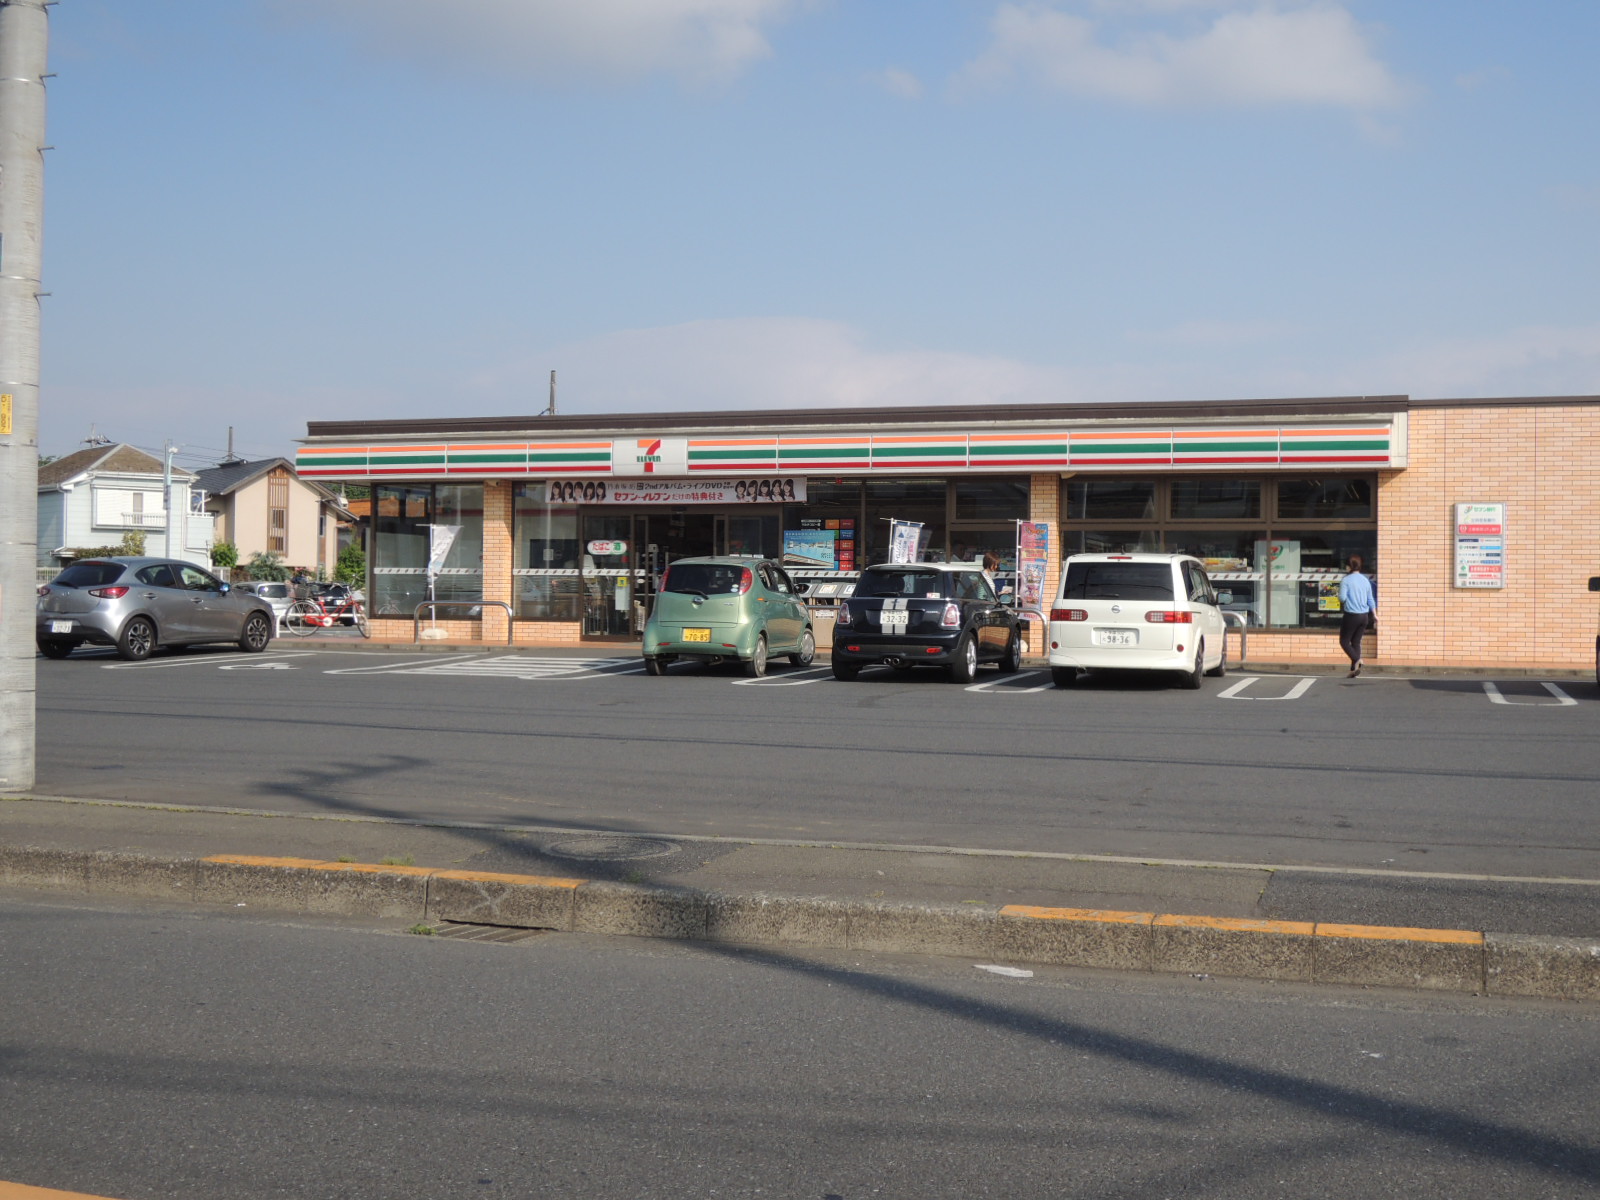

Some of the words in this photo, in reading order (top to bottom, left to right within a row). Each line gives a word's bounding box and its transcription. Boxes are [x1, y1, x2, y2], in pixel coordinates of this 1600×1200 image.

[637, 439, 661, 472] 7
[886, 615, 907, 623] 32-32
[1107, 635, 1130, 644] 98-36
